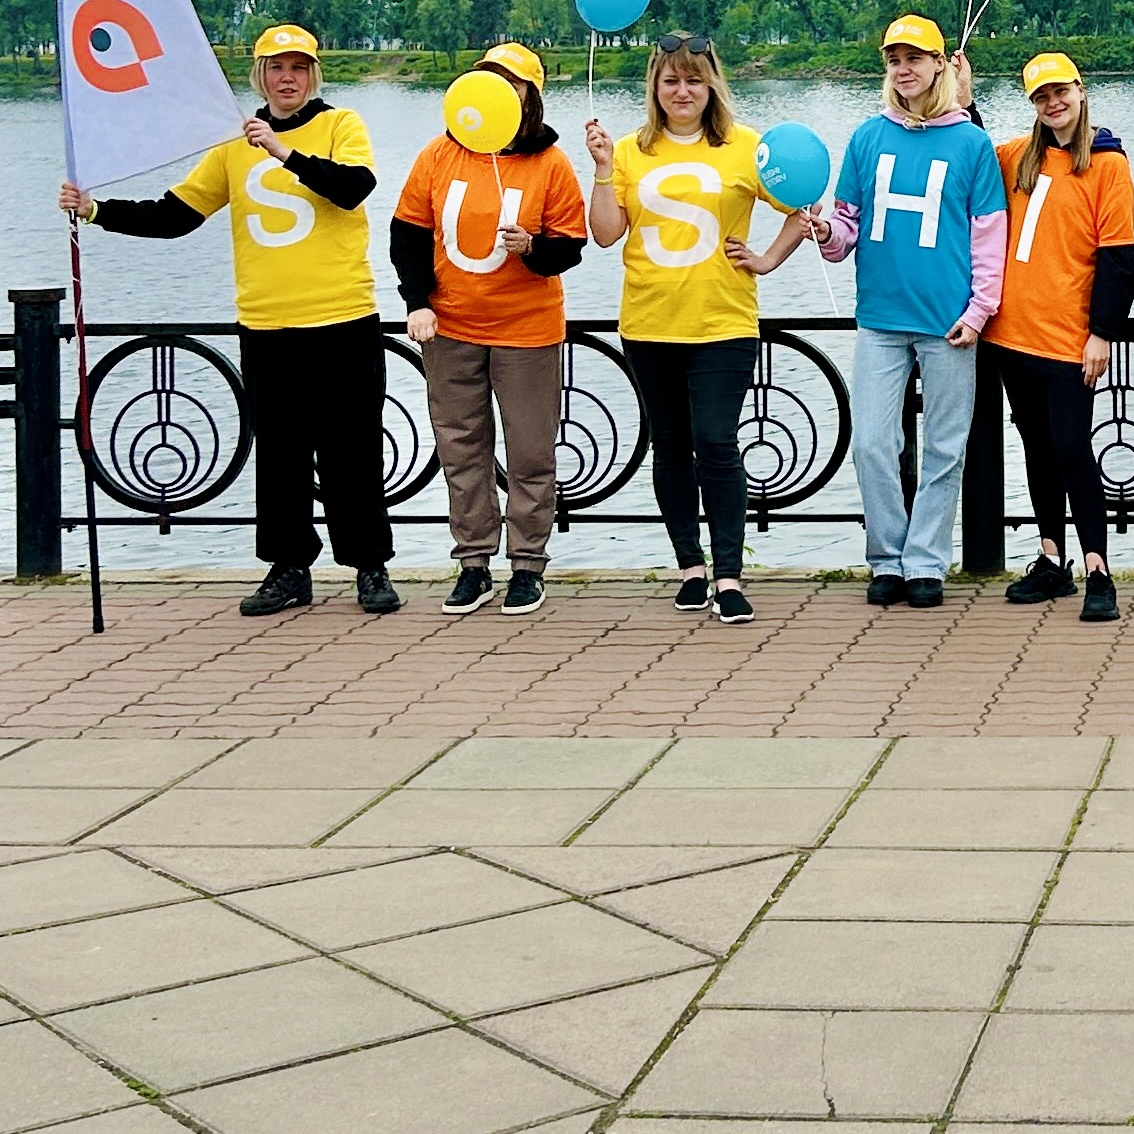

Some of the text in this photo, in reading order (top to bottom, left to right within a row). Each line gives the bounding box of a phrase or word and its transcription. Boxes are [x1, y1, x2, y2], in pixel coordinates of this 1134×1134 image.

[245, 156, 315, 248] S
[442, 179, 523, 274] U
[637, 162, 722, 268] S
[870, 153, 949, 248] H
[1015, 173, 1053, 263] I
